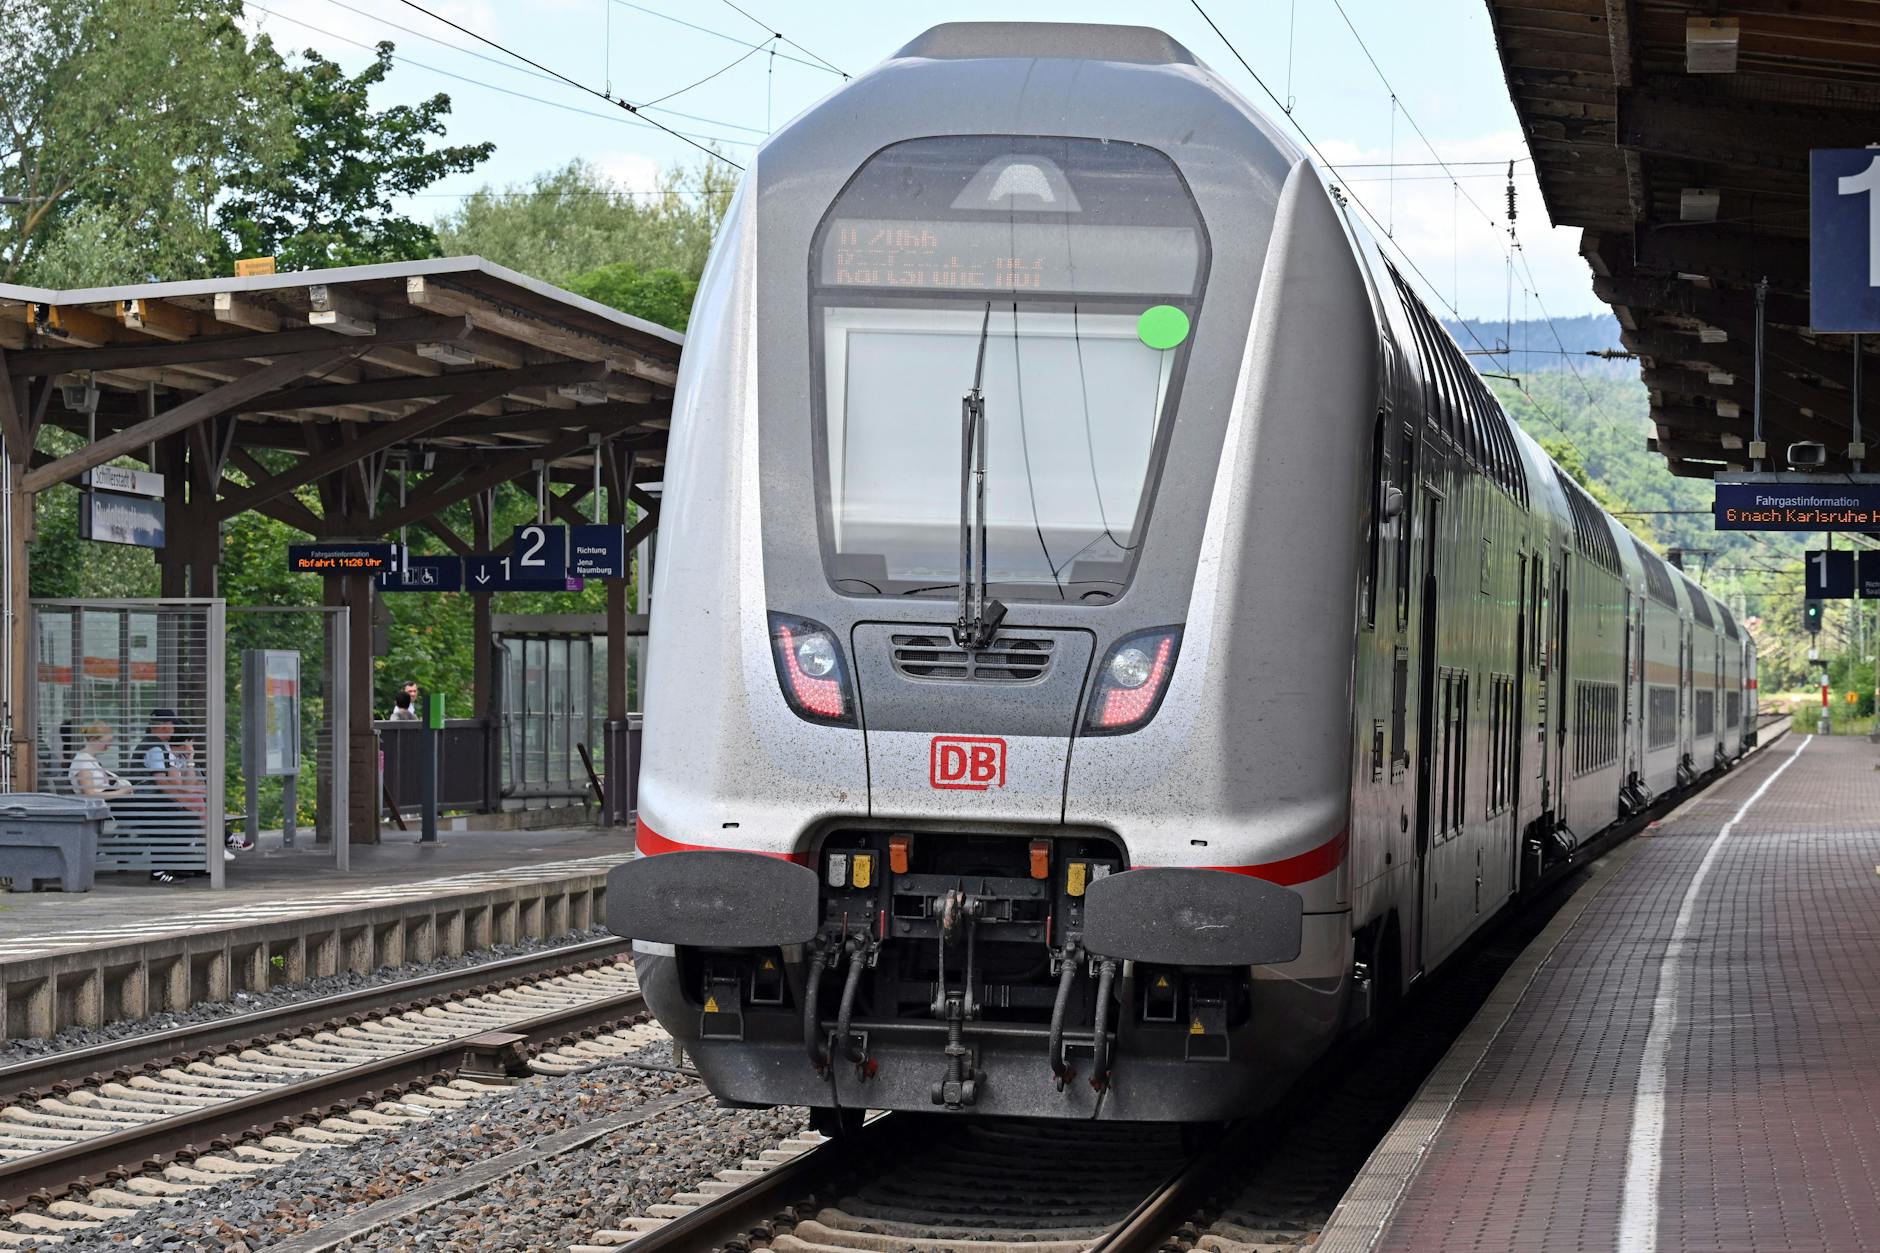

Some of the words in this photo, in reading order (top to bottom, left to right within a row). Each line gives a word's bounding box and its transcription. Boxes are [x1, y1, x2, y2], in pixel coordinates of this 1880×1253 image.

[1838, 155, 1880, 287] 1
[1755, 495, 1860, 508] Fahrgastinformation
[1726, 508, 1737, 522] 6
[1741, 509, 1781, 522] nach
[1786, 509, 1868, 523] Karlsruhe
[520, 526, 546, 566] 2
[577, 546, 607, 555] Richtung
[298, 558, 336, 568] Abfahrt
[338, 558, 363, 568] 11:26
[365, 558, 383, 567] Uhr
[500, 556, 511, 581] 1
[577, 566, 612, 575] Naumburg
[1811, 551, 1827, 588] 1
[940, 745, 997, 782] DB
